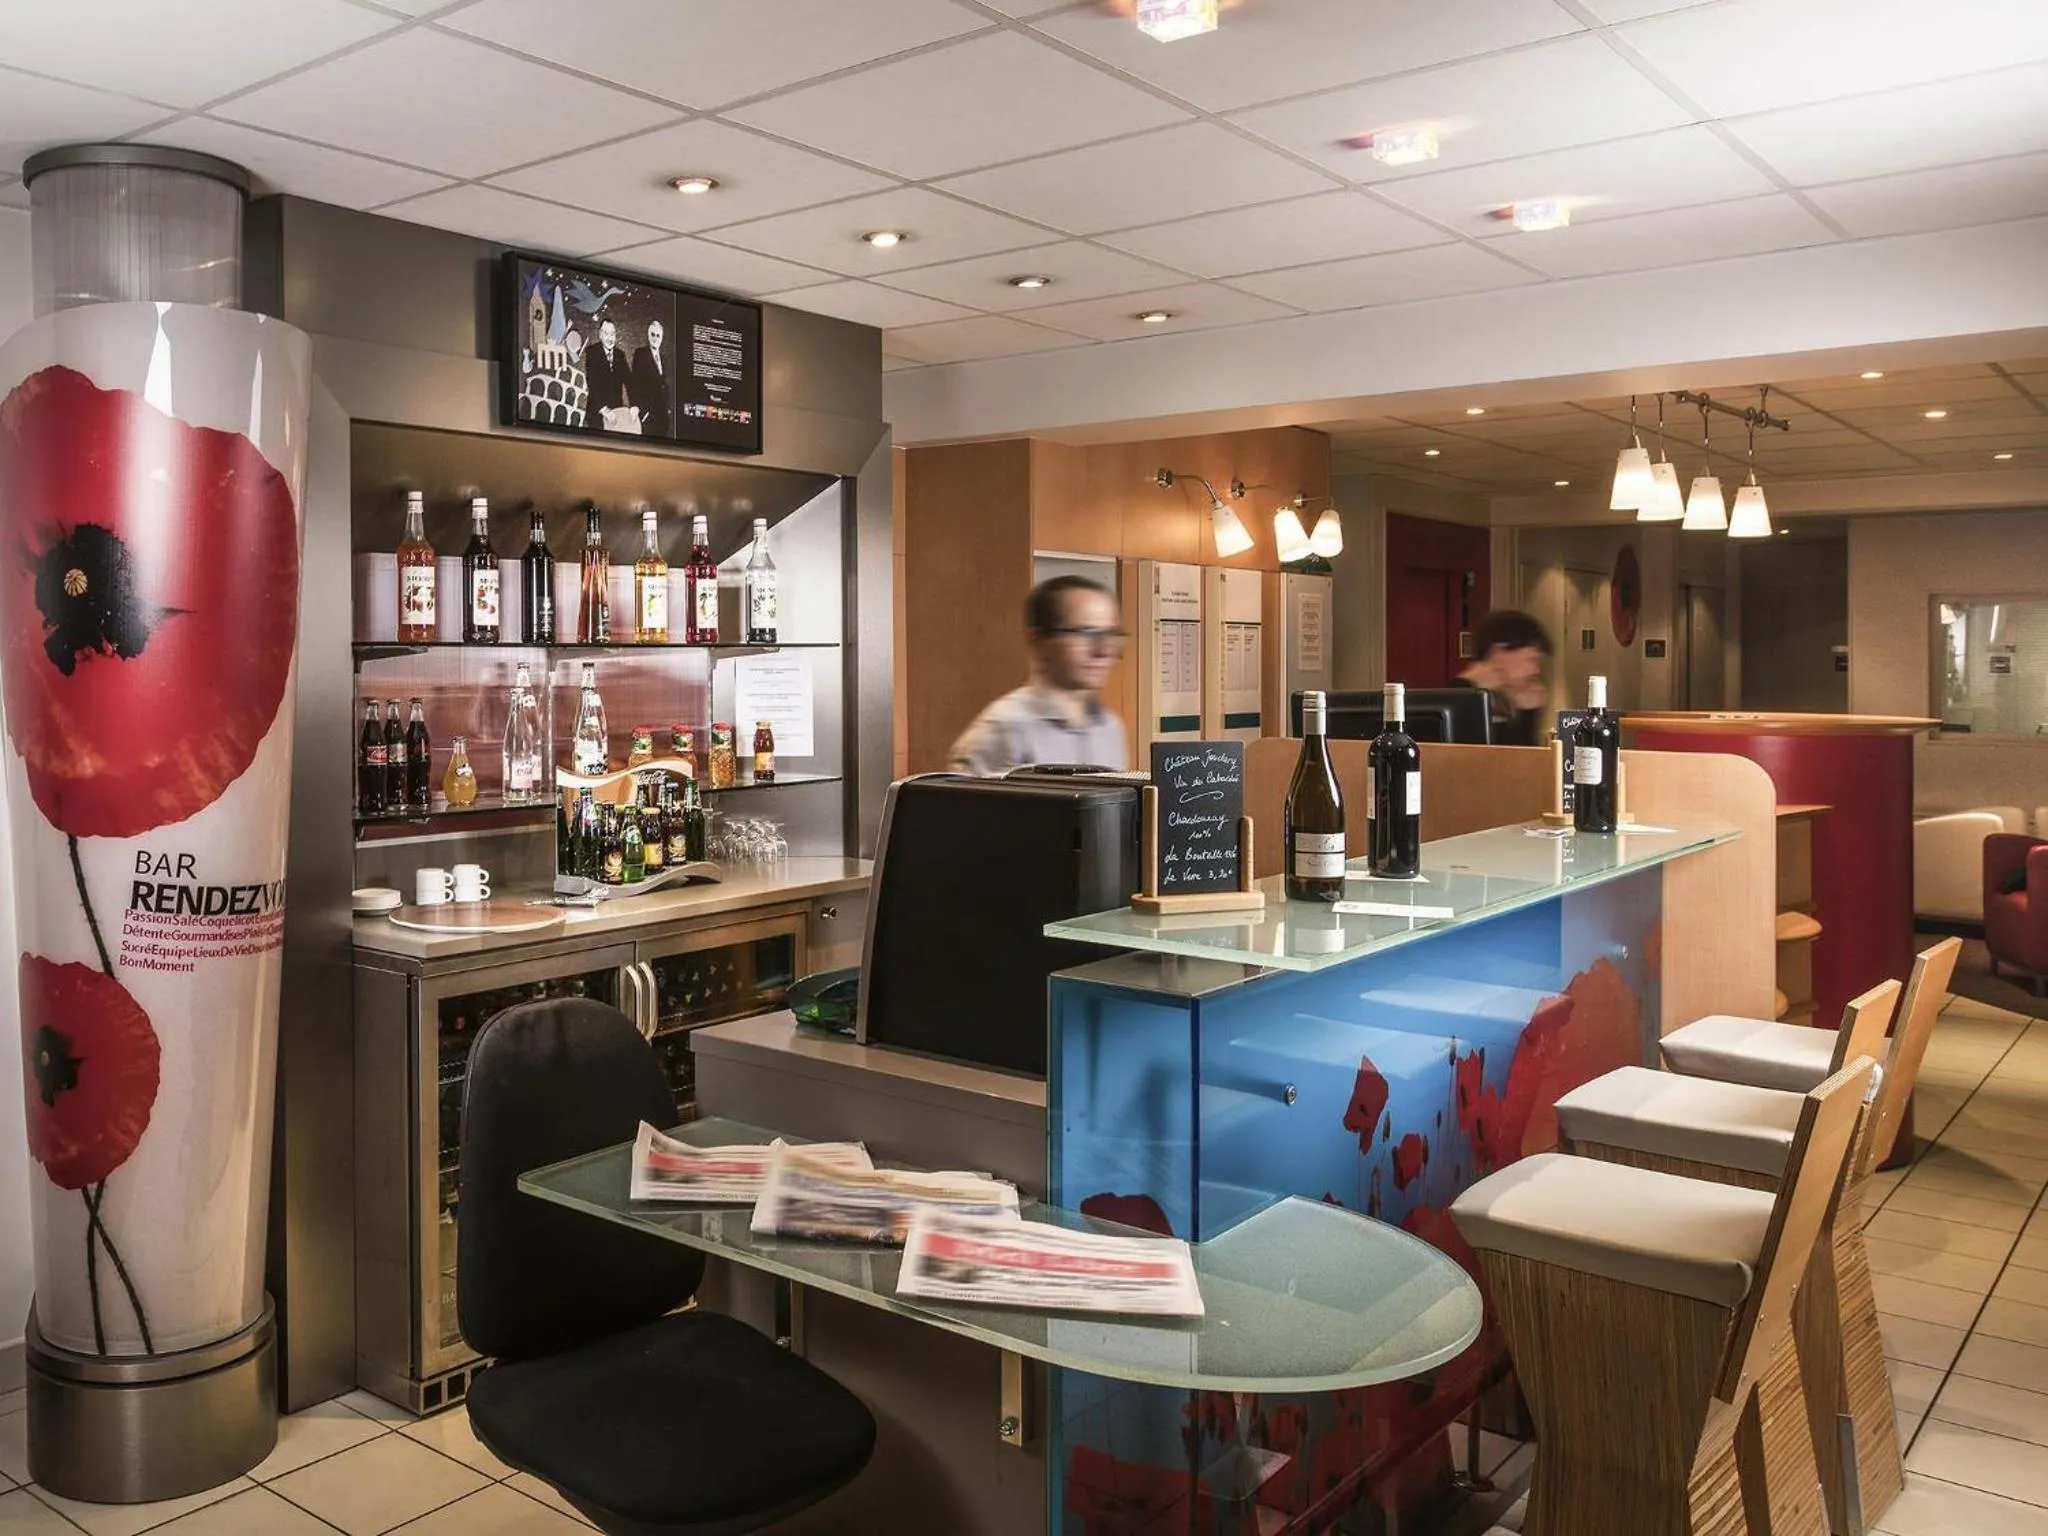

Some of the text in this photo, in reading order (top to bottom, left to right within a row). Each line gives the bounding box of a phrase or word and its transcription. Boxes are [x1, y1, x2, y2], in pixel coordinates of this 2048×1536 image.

[1168, 811, 1229, 831] Chardonnay
[135, 850, 197, 880] BAR
[119, 954, 197, 973] BonMoment
